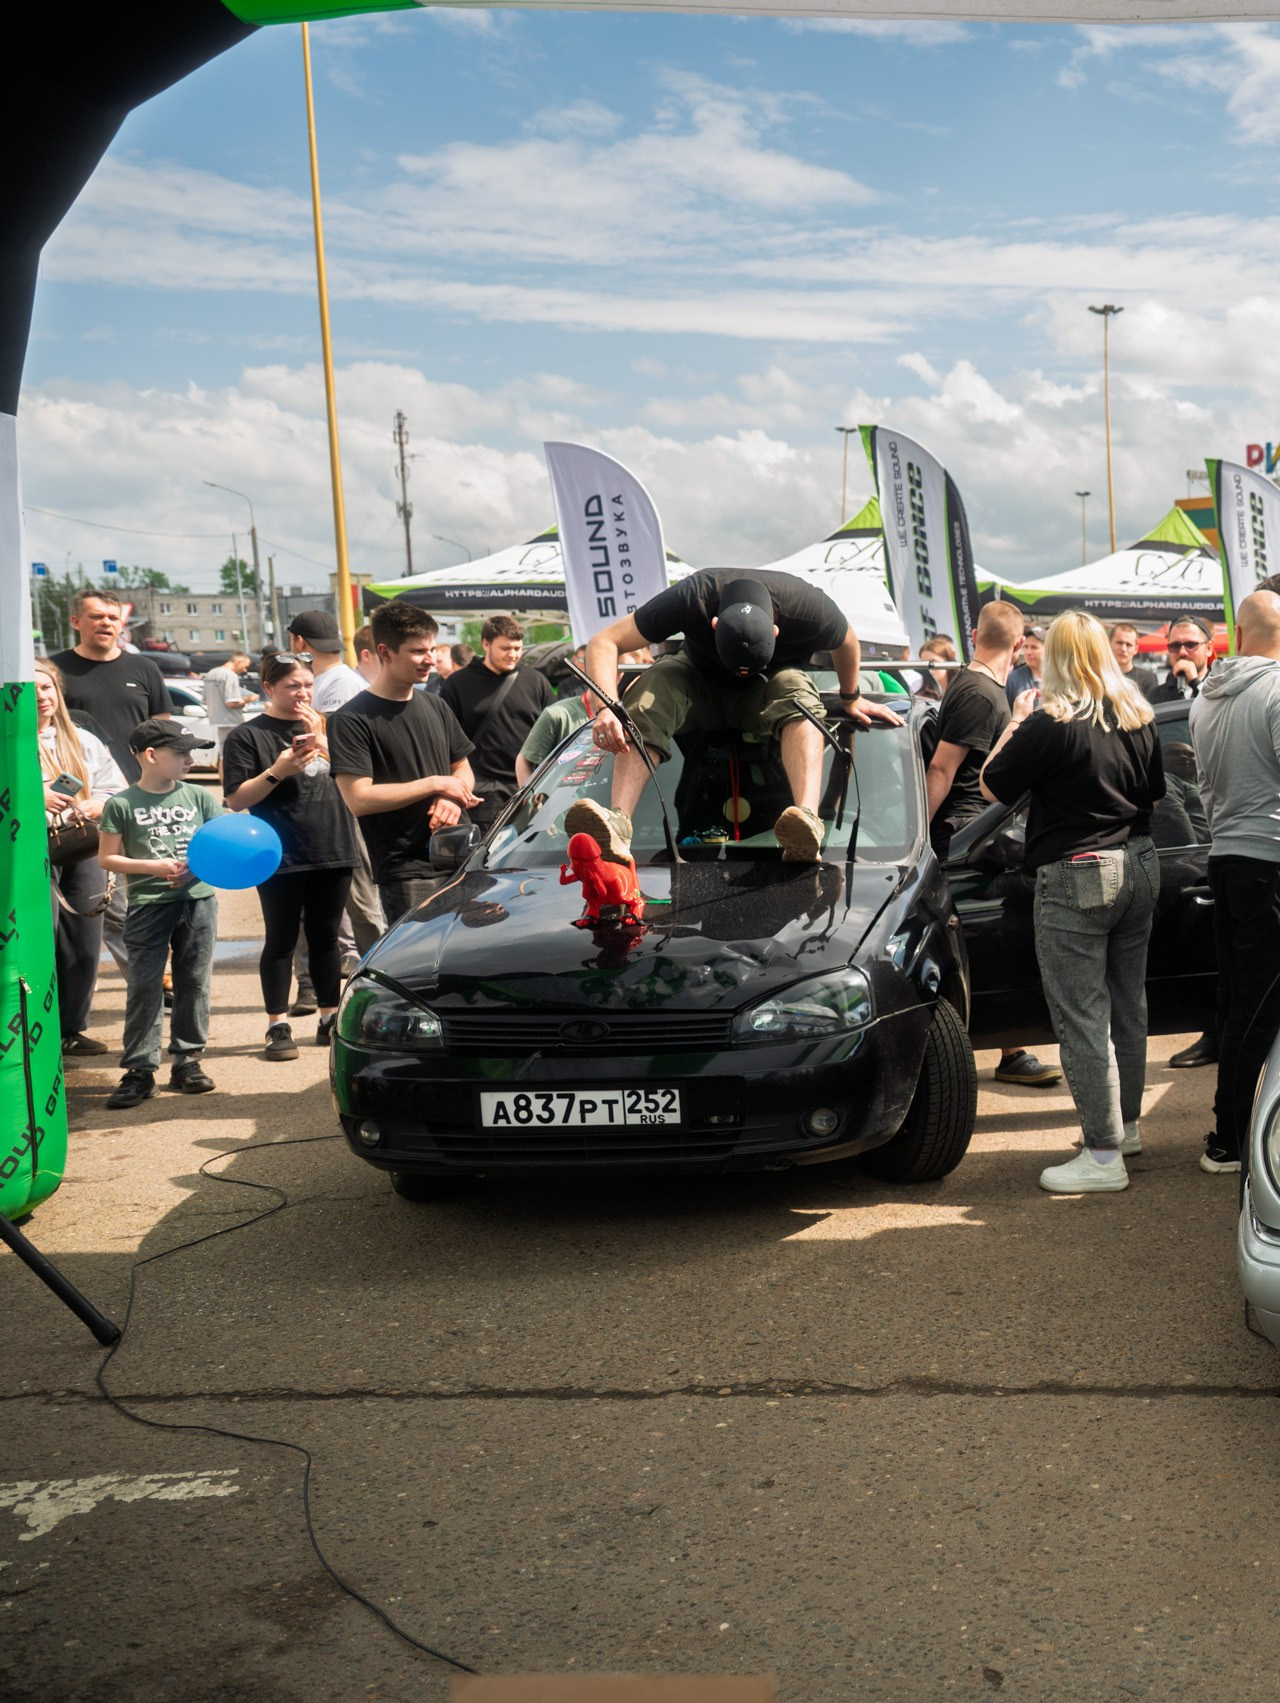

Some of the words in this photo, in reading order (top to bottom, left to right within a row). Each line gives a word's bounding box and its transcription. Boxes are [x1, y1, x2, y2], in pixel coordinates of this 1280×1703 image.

[889, 441, 902, 480] SOUND
[895, 483, 907, 528] CREATE
[1233, 474, 1244, 508] SOUND
[900, 530, 908, 548] WE
[906, 461, 934, 599] BONCE
[1236, 510, 1248, 549] CREATE
[1248, 491, 1269, 582] ONCE
[585, 494, 617, 618] SOUND
[612, 494, 638, 614] ВТОЗВУКА
[953, 521, 967, 586] TECHNOLOGIES
[1240, 553, 1249, 568] WE
[445, 588, 566, 598] HTTPS://ALPHARDAUD
[1085, 600, 1224, 611] HTTPS://ALPHARDAUDIO.R
[133, 805, 198, 826] ENJOY
[147, 825, 172, 837] THE
[626, 1089, 678, 1114] 252
[640, 1114, 666, 1124] RUS
